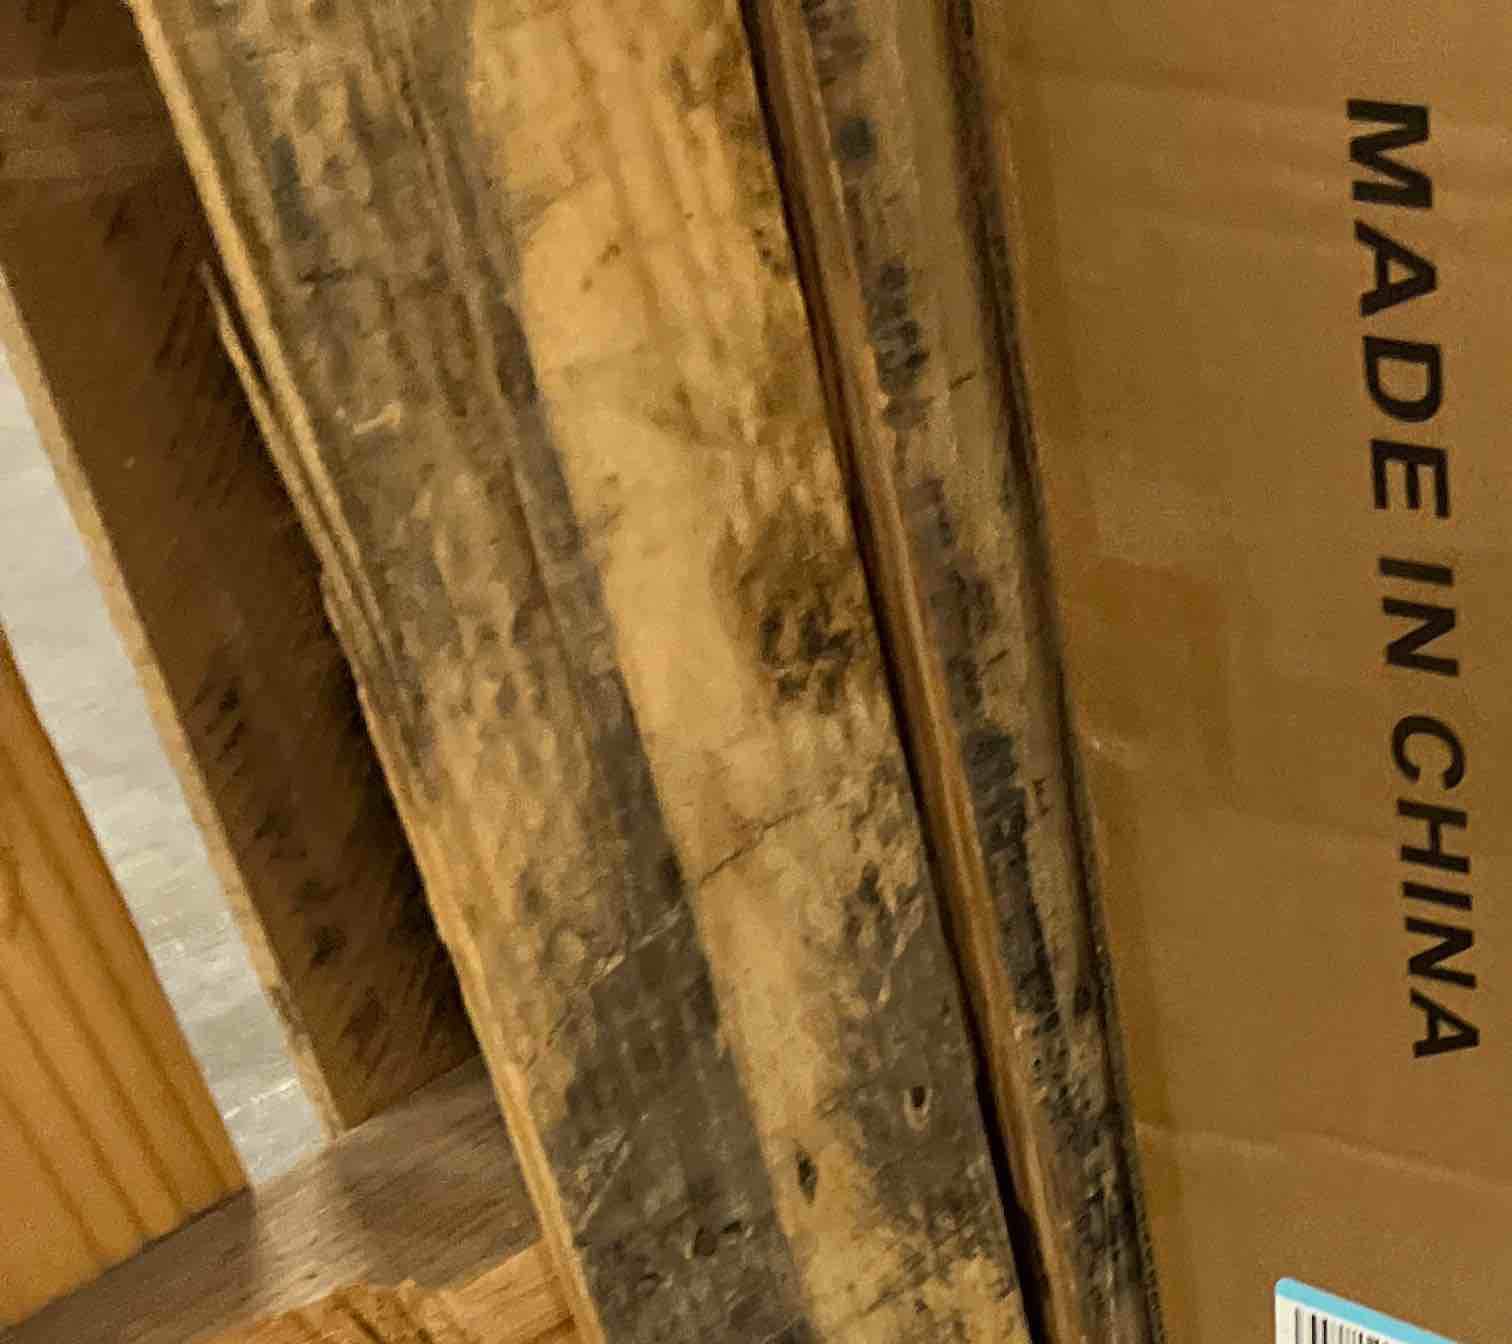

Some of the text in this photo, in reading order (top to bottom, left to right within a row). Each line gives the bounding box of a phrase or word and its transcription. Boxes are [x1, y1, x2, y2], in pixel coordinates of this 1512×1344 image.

[1346, 98, 1482, 1062] MADE IN CHINA
